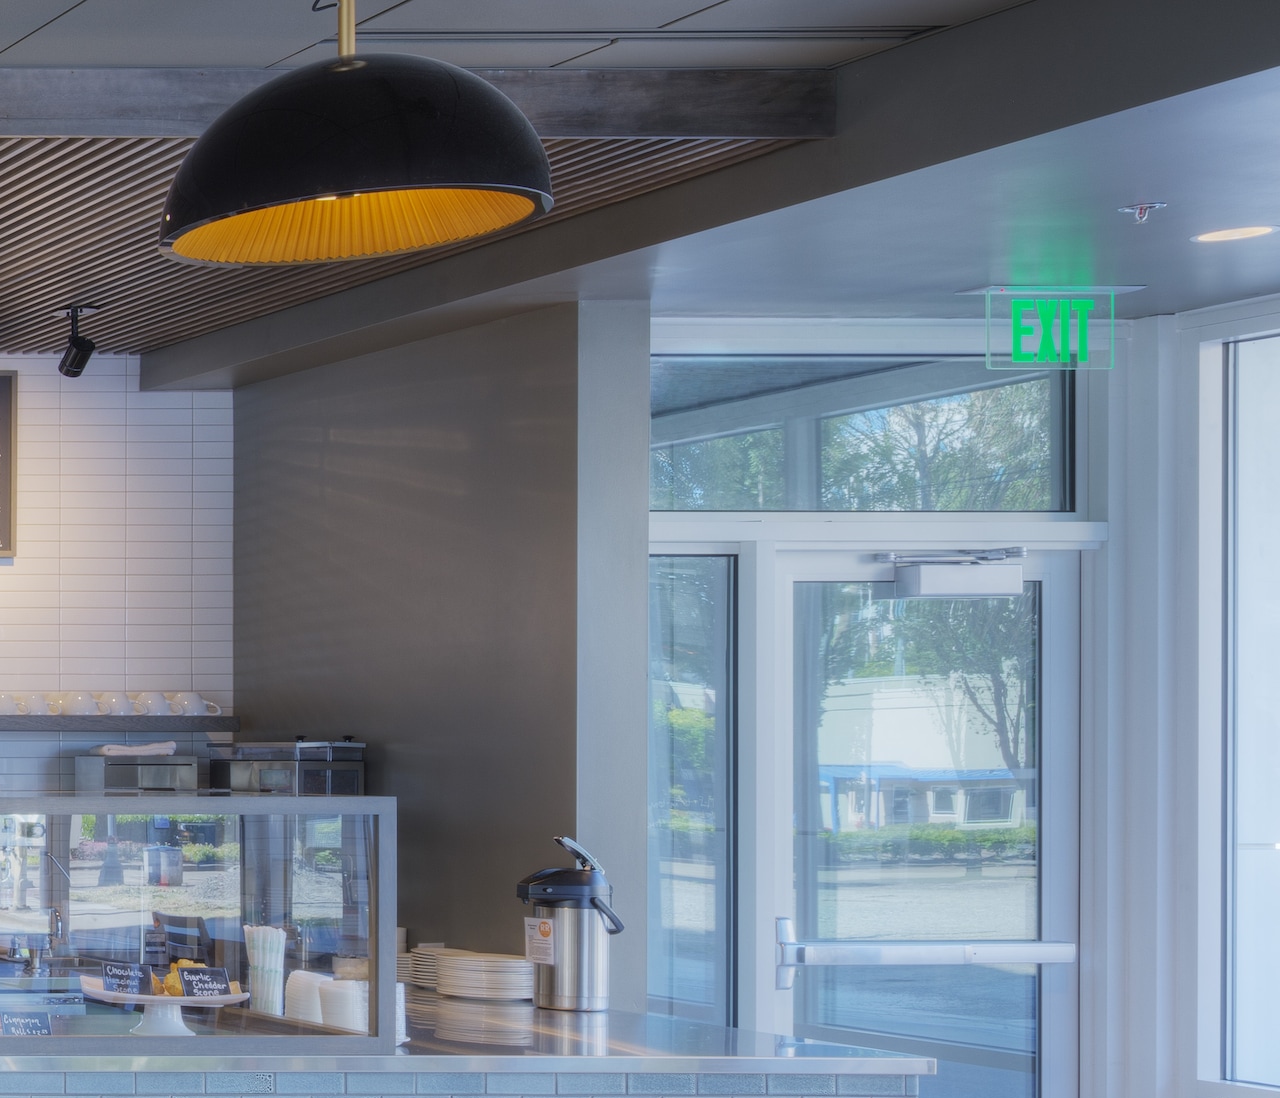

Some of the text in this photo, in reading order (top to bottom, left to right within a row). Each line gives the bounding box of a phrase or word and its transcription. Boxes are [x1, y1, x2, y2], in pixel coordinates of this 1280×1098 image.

[1011, 299, 1095, 363] EXIT
[106, 966, 144, 978] Chocolate
[184, 971, 212, 982] Garlic
[105, 976, 140, 986] Hazelnut
[113, 984, 138, 994] Scone
[3, 1015, 41, 1028] Cinnamon
